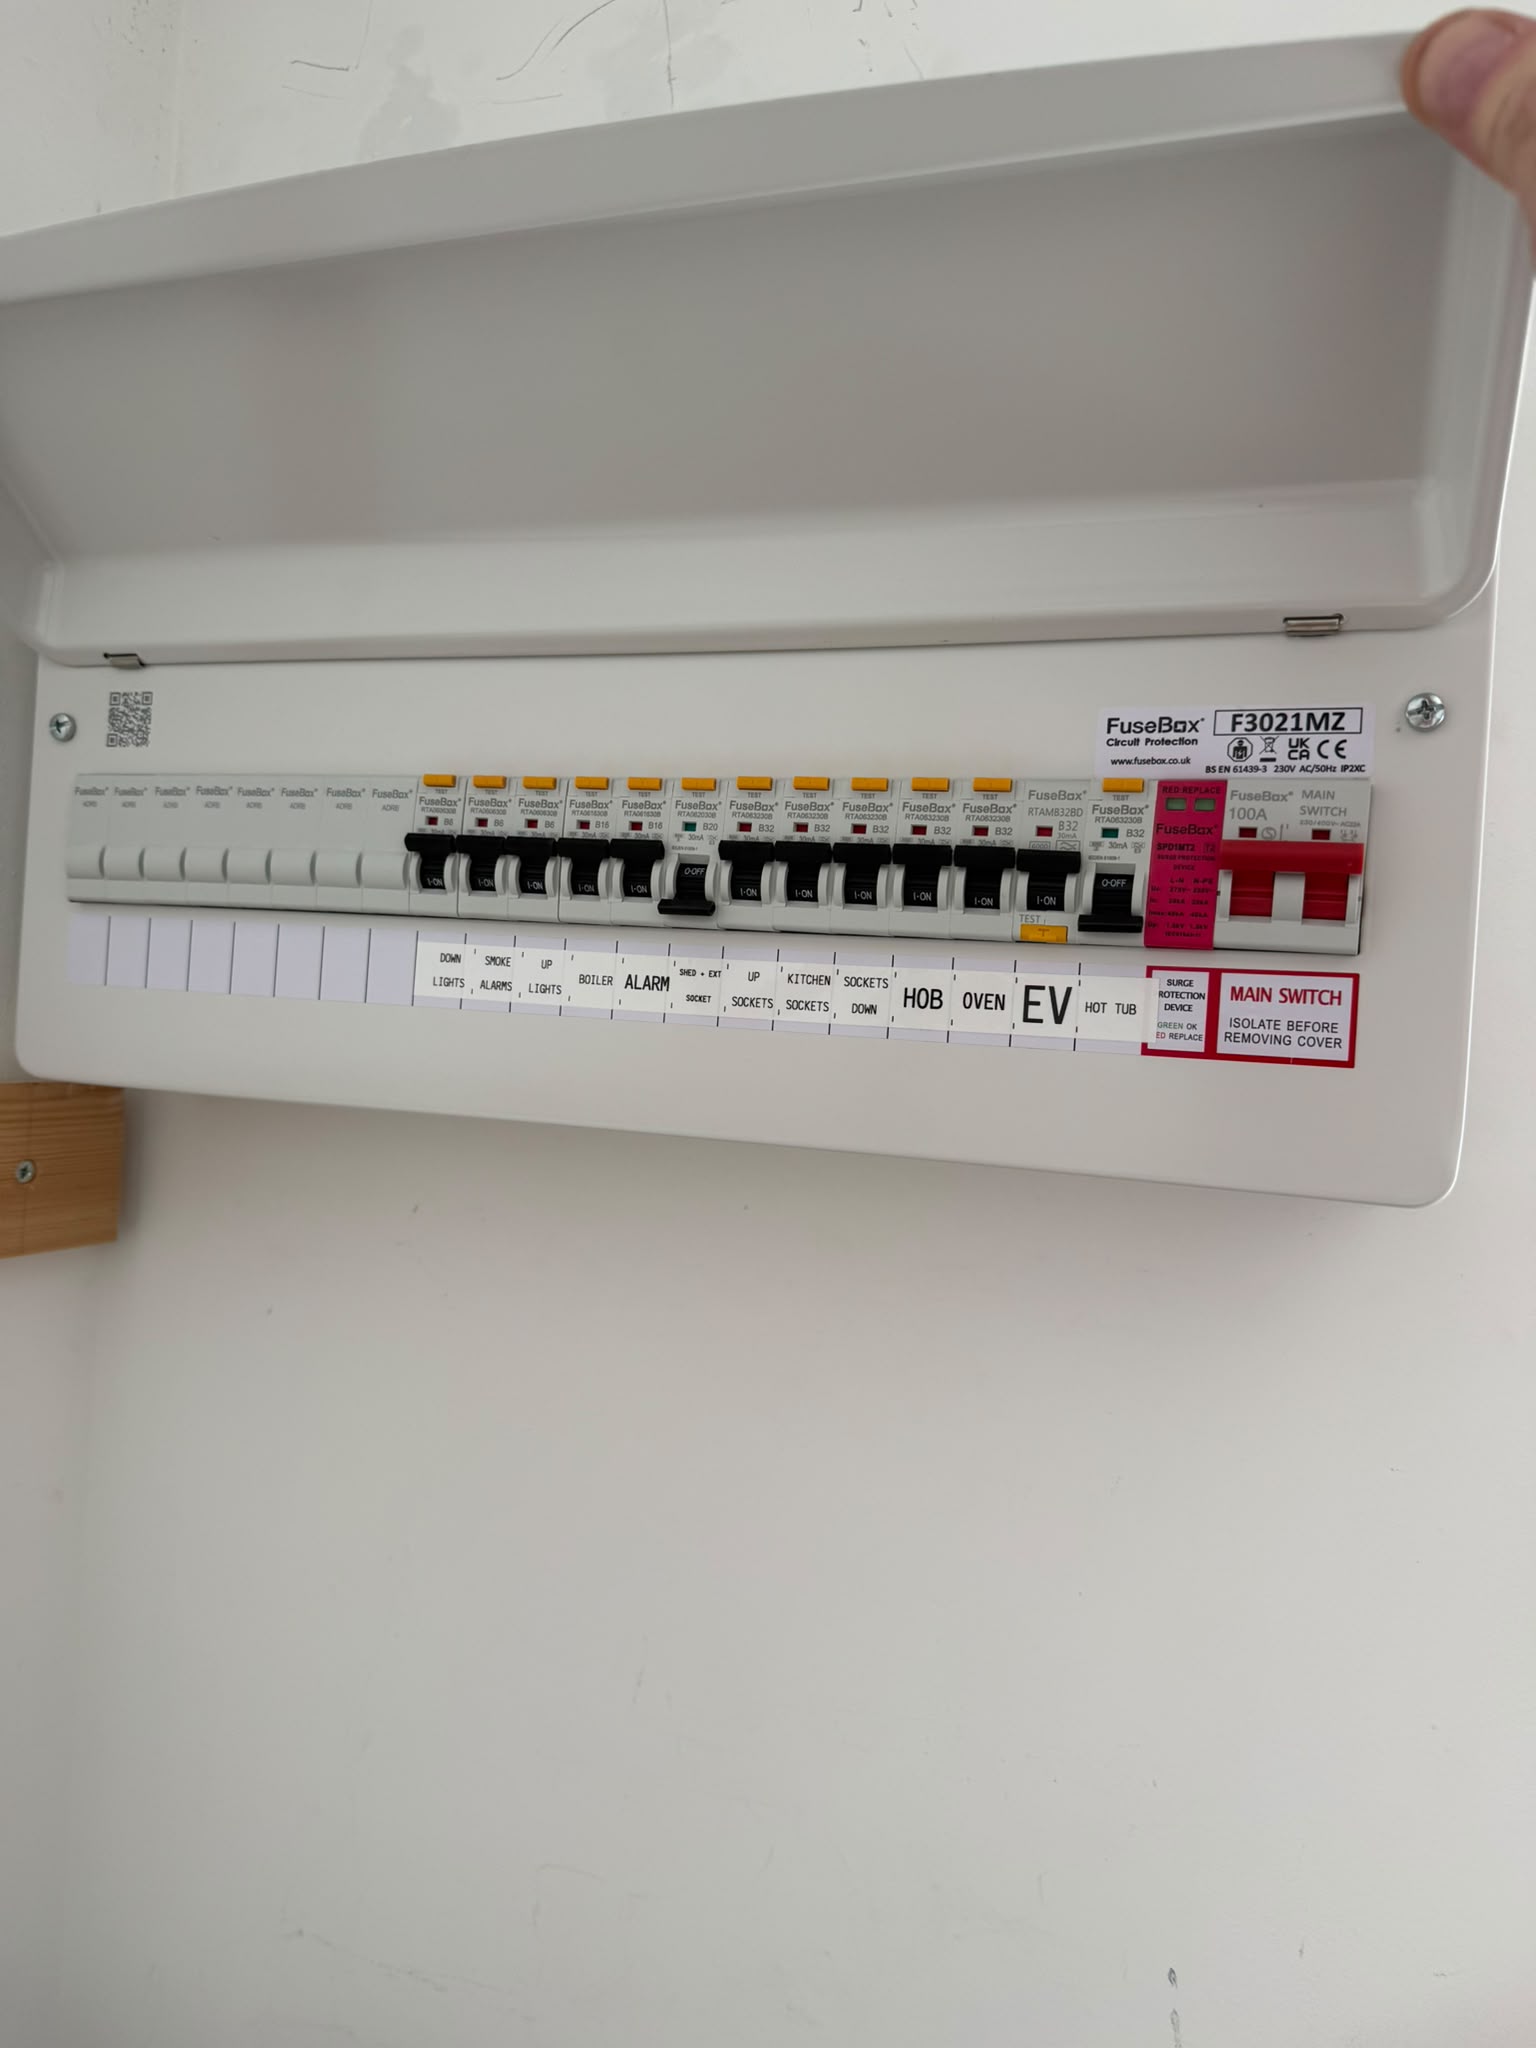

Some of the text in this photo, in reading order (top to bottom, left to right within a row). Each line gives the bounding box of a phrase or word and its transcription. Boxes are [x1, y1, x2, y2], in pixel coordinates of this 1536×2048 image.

[1107, 716, 1200, 735] FuseBox
[1231, 712, 1346, 733] F3021MZ
[1106, 737, 1198, 747] Circuit Protection
[1288, 737, 1310, 749] UK
[1111, 756, 1191, 766] www.fusebox.co.uk
[1206, 764, 1366, 773] BS EN 61439-3 230V AC/50Hz IP2XC
[372, 788, 409, 798] FuseBox
[1028, 790, 1082, 801] FuseBox
[1183, 786, 1220, 794] REPLACE
[1302, 790, 1335, 800] MAIN
[419, 796, 458, 807] FuseBox
[1230, 790, 1288, 802] FuseBox
[468, 797, 508, 808] FuseBox
[518, 798, 559, 809] FuseBox
[569, 800, 609, 809] FuseBox
[622, 800, 663, 810] FuseBox
[675, 800, 717, 811] FuseBox
[729, 801, 775, 812] FuseBox
[785, 801, 830, 812] FuseBox
[842, 802, 889, 812] FuseBox
[902, 802, 951, 813] FuseBox
[963, 803, 1012, 814] FuseBox
[1092, 804, 1145, 815] FuseBox
[1300, 805, 1347, 817] SWITCH
[1230, 808, 1267, 821] 100A
[703, 823, 718, 831] B20
[759, 824, 774, 832] B32
[814, 824, 830, 832] B32
[873, 825, 889, 833] B32
[934, 826, 951, 834] B32
[995, 827, 1013, 835] B32
[1058, 821, 1078, 831] B32
[1156, 823, 1213, 835] FuseBox
[1127, 829, 1144, 837] B32
[1019, 914, 1040, 923] TEST
[440, 953, 461, 964] DOWN
[485, 955, 511, 967] SMOKE
[541, 959, 553, 969] UP
[679, 968, 697, 977] SHED
[708, 970, 721, 978] EXT
[748, 971, 760, 982] UP
[433, 977, 465, 988] LIGHTS
[579, 974, 613, 986] BOILER
[624, 974, 670, 992] ALARM
[787, 973, 831, 986] KITCHEN
[843, 977, 889, 989] SOCKETS
[1167, 979, 1194, 988] SURGE
[480, 980, 512, 992] ALARMS
[528, 983, 562, 995] LIGHTS
[686, 994, 711, 1003] SOCKET
[903, 987, 943, 1009] HOB
[1158, 991, 1206, 1000] ROTECTION
[1230, 986, 1342, 1006] MAIN SWITCH
[732, 996, 774, 1009] SOCKETS
[786, 999, 829, 1012] SOCKETS
[963, 992, 1006, 1011] OVEN
[1022, 984, 1073, 1025] EV
[852, 1003, 877, 1015] DOWN
[1085, 1001, 1137, 1015] HOT TUB
[1164, 1003, 1193, 1012] DEVICE
[1157, 1021, 1197, 1031] GREEN OK
[1229, 1017, 1339, 1034] ISOLATE BEFORE
[1155, 1031, 1203, 1042] ED REPLACE
[1224, 1032, 1342, 1049] REMOVING COVER
